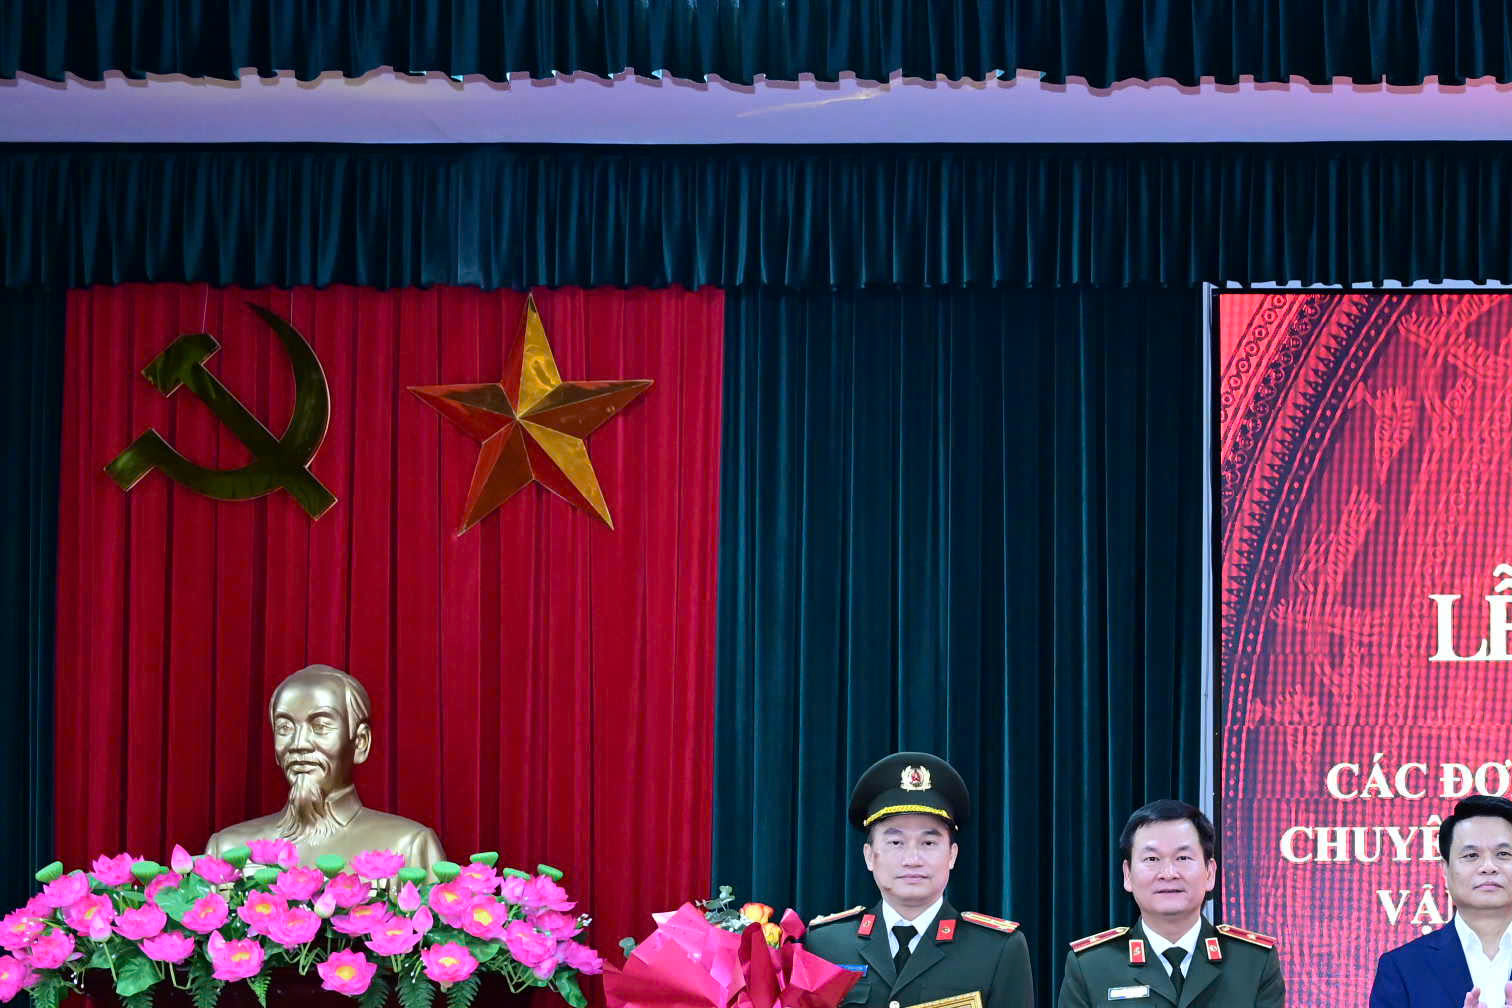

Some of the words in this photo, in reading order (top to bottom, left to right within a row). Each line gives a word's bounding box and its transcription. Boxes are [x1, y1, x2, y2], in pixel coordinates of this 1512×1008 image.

[1326, 752, 1428, 799] CÁC
[1280, 814, 1443, 862] CHUYÊ
[1375, 883, 1454, 935] VẬ
